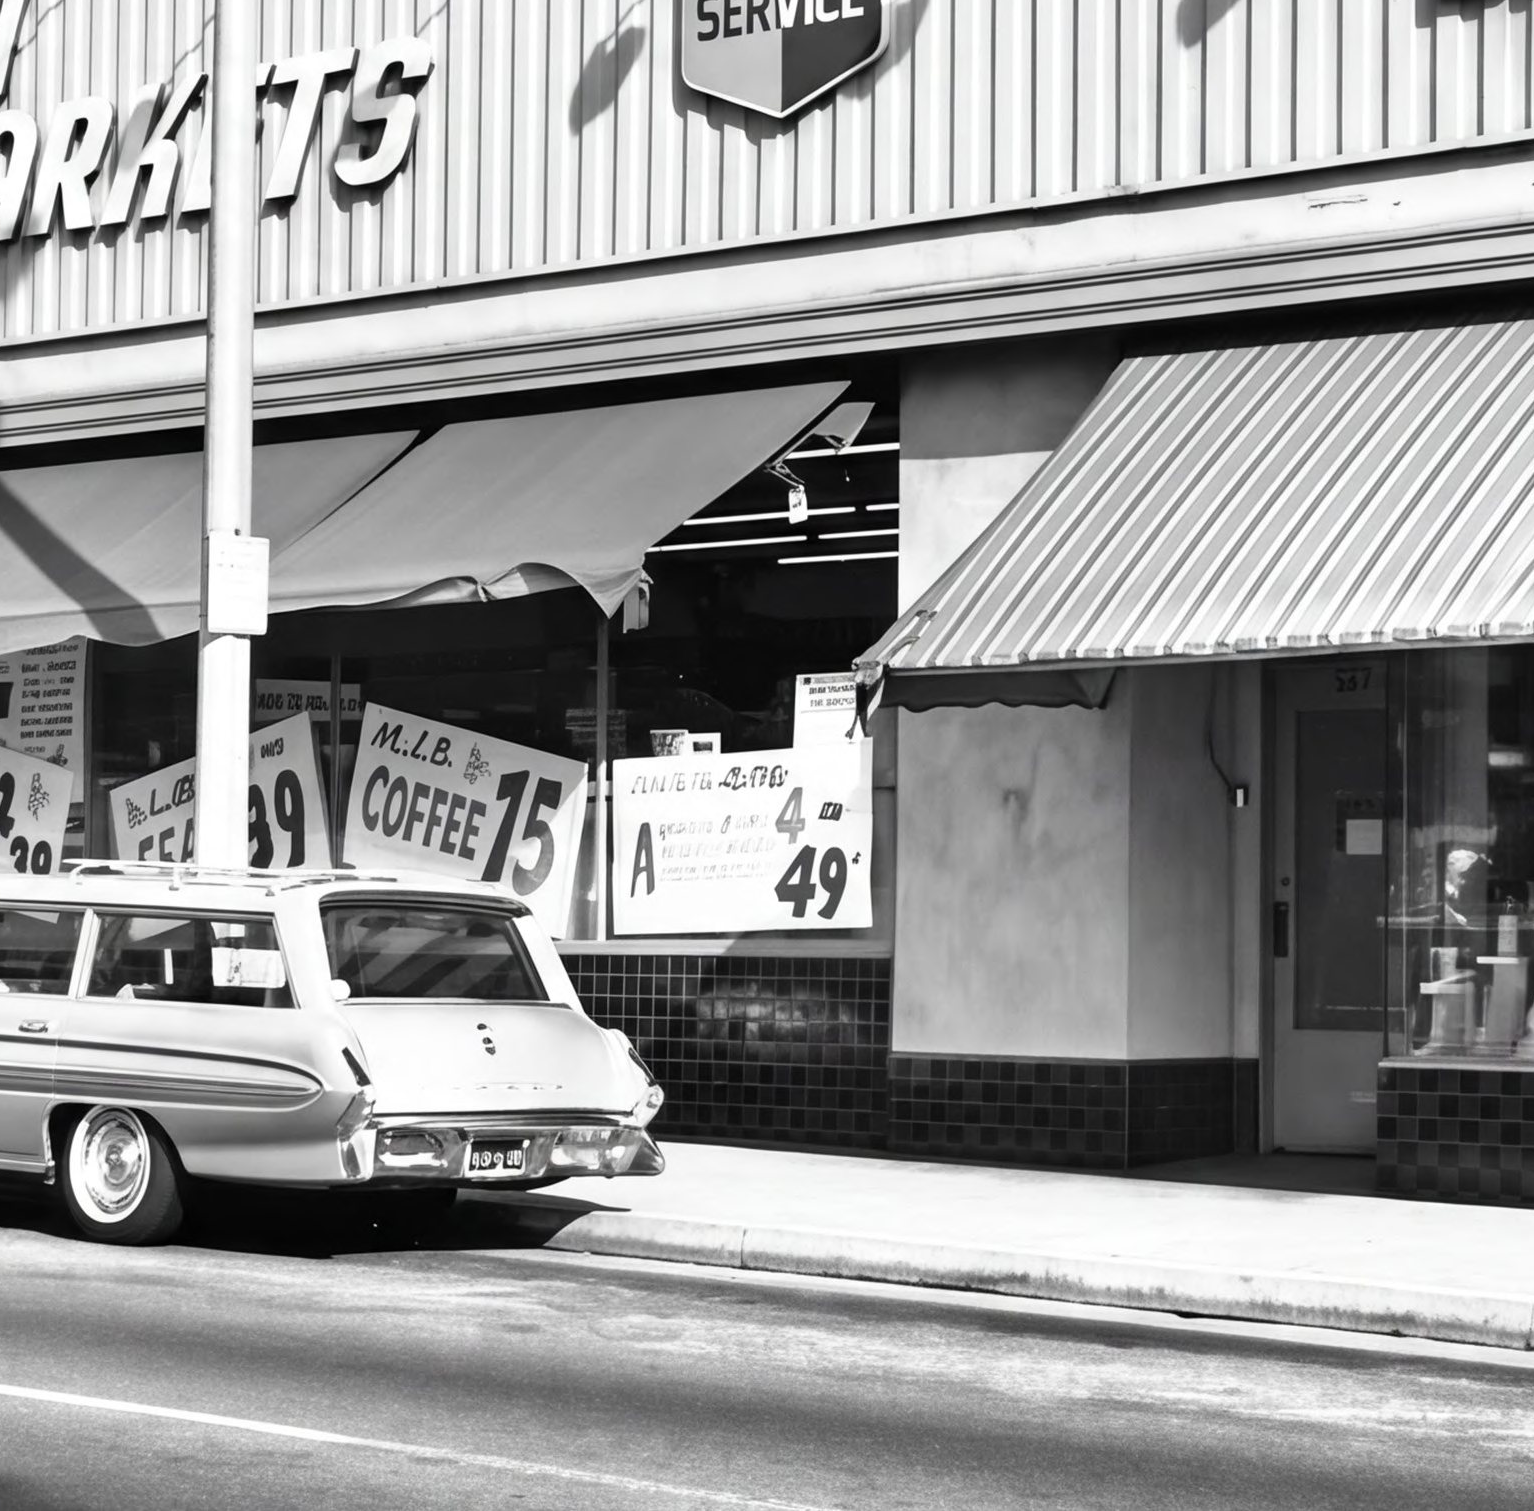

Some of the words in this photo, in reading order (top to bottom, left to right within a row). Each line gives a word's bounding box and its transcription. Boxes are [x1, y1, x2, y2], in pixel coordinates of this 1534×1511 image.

[361, 764, 488, 861] COFFEE
[774, 786, 806, 845] 4
[774, 844, 849, 920] 49
